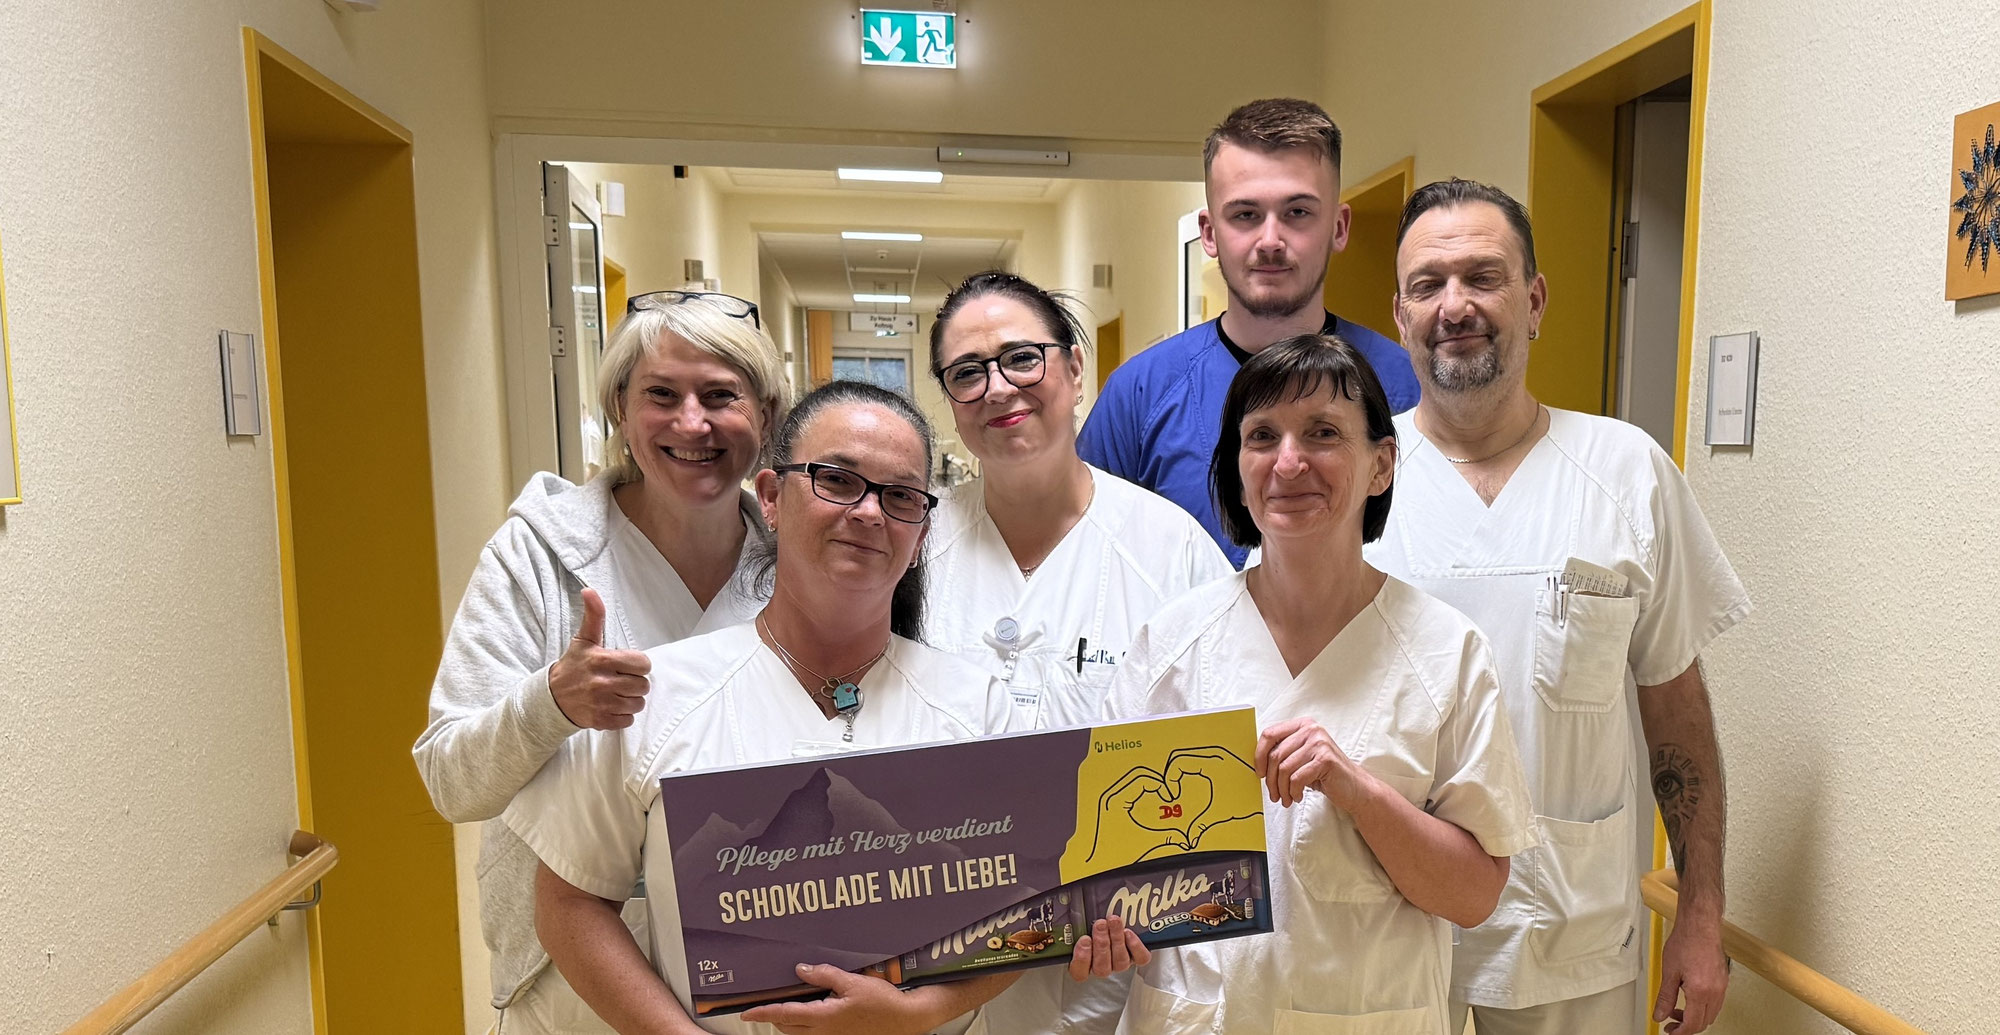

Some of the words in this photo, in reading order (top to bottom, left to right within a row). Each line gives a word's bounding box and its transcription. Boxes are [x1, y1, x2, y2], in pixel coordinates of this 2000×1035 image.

[1105, 739, 1142, 751] Helios
[716, 846, 798, 876] Pflege
[802, 836, 845, 860] mit
[850, 830, 912, 854] Herz
[916, 815, 1013, 844] verdient
[718, 871, 882, 924] SCHOKOLADE
[890, 864, 933, 900] MIT
[943, 853, 1017, 893] LIEBE!
[1106, 868, 1214, 928] Milka
[1151, 913, 1189, 931] OREO
[697, 960, 719, 971] 12x
